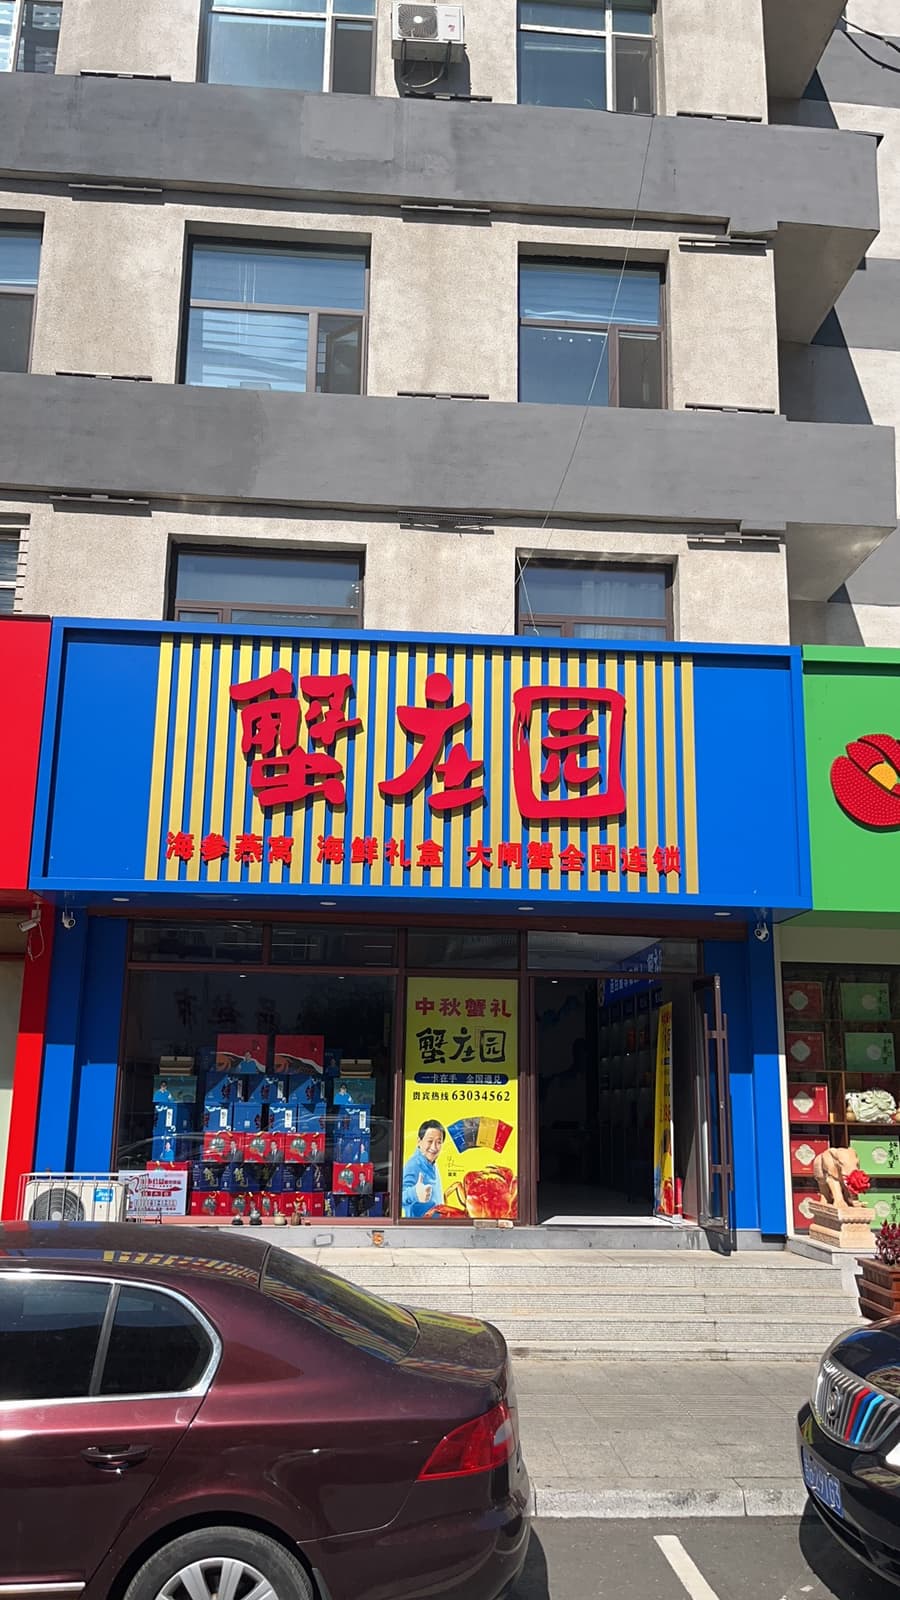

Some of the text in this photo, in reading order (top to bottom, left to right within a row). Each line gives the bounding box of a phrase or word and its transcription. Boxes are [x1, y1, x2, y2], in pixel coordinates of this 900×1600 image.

[229, 667, 626, 819] 蟹庄园
[166, 831, 681, 874] 海参燕窝 海鲜礼盒 大闸蟹全国连锁
[415, 997, 511, 1018] 中秋蟹礼
[416, 1026, 506, 1064] 蟹庄园
[451, 1090, 511, 1102] 63034562
